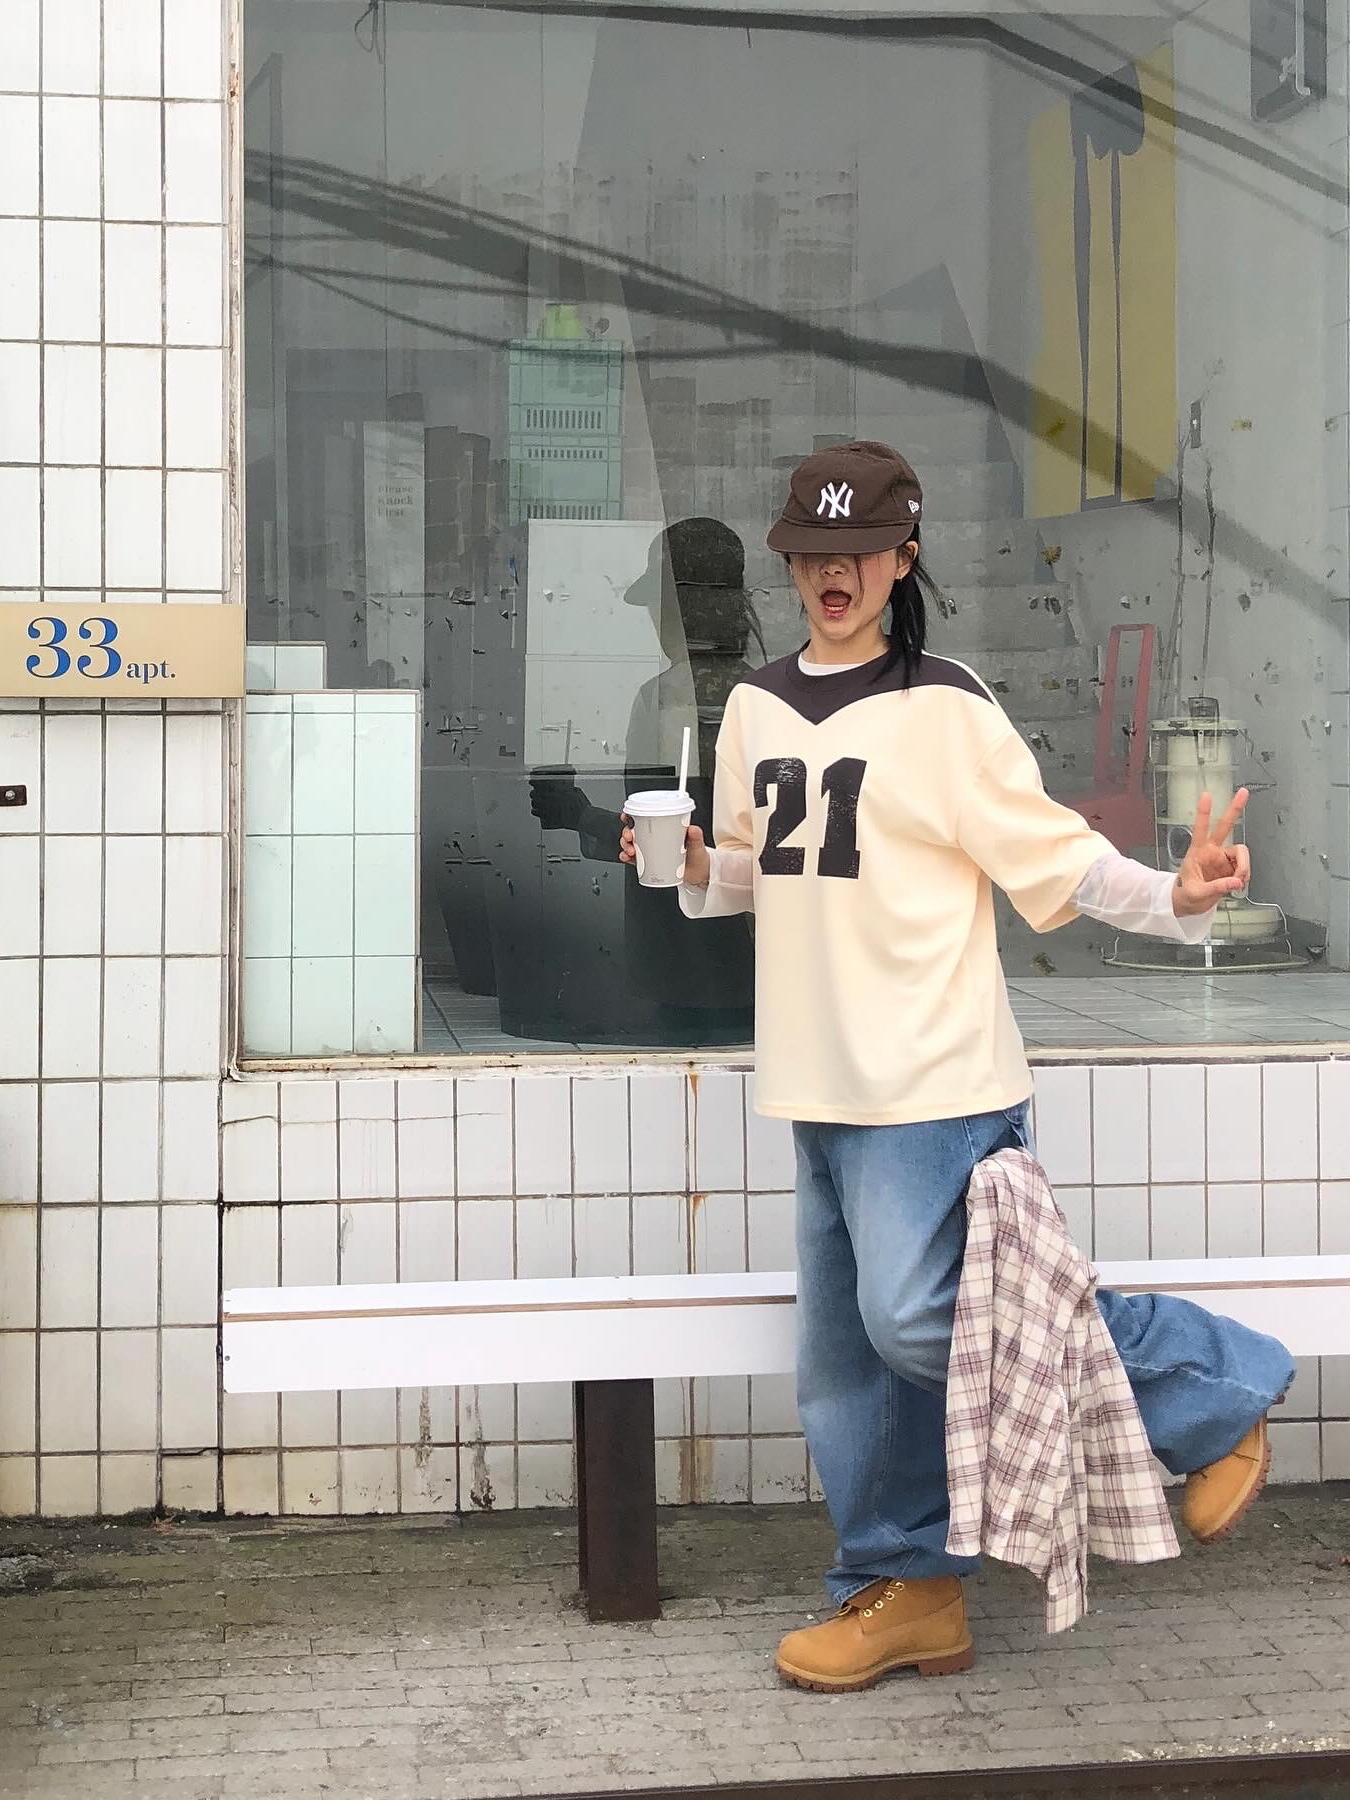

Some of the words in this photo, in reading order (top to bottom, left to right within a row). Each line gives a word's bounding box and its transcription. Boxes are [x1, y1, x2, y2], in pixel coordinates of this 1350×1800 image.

[816, 481, 854, 519] NY
[26, 616, 122, 679] 33
[126, 659, 177, 684] apt.
[753, 757, 867, 880] 21
